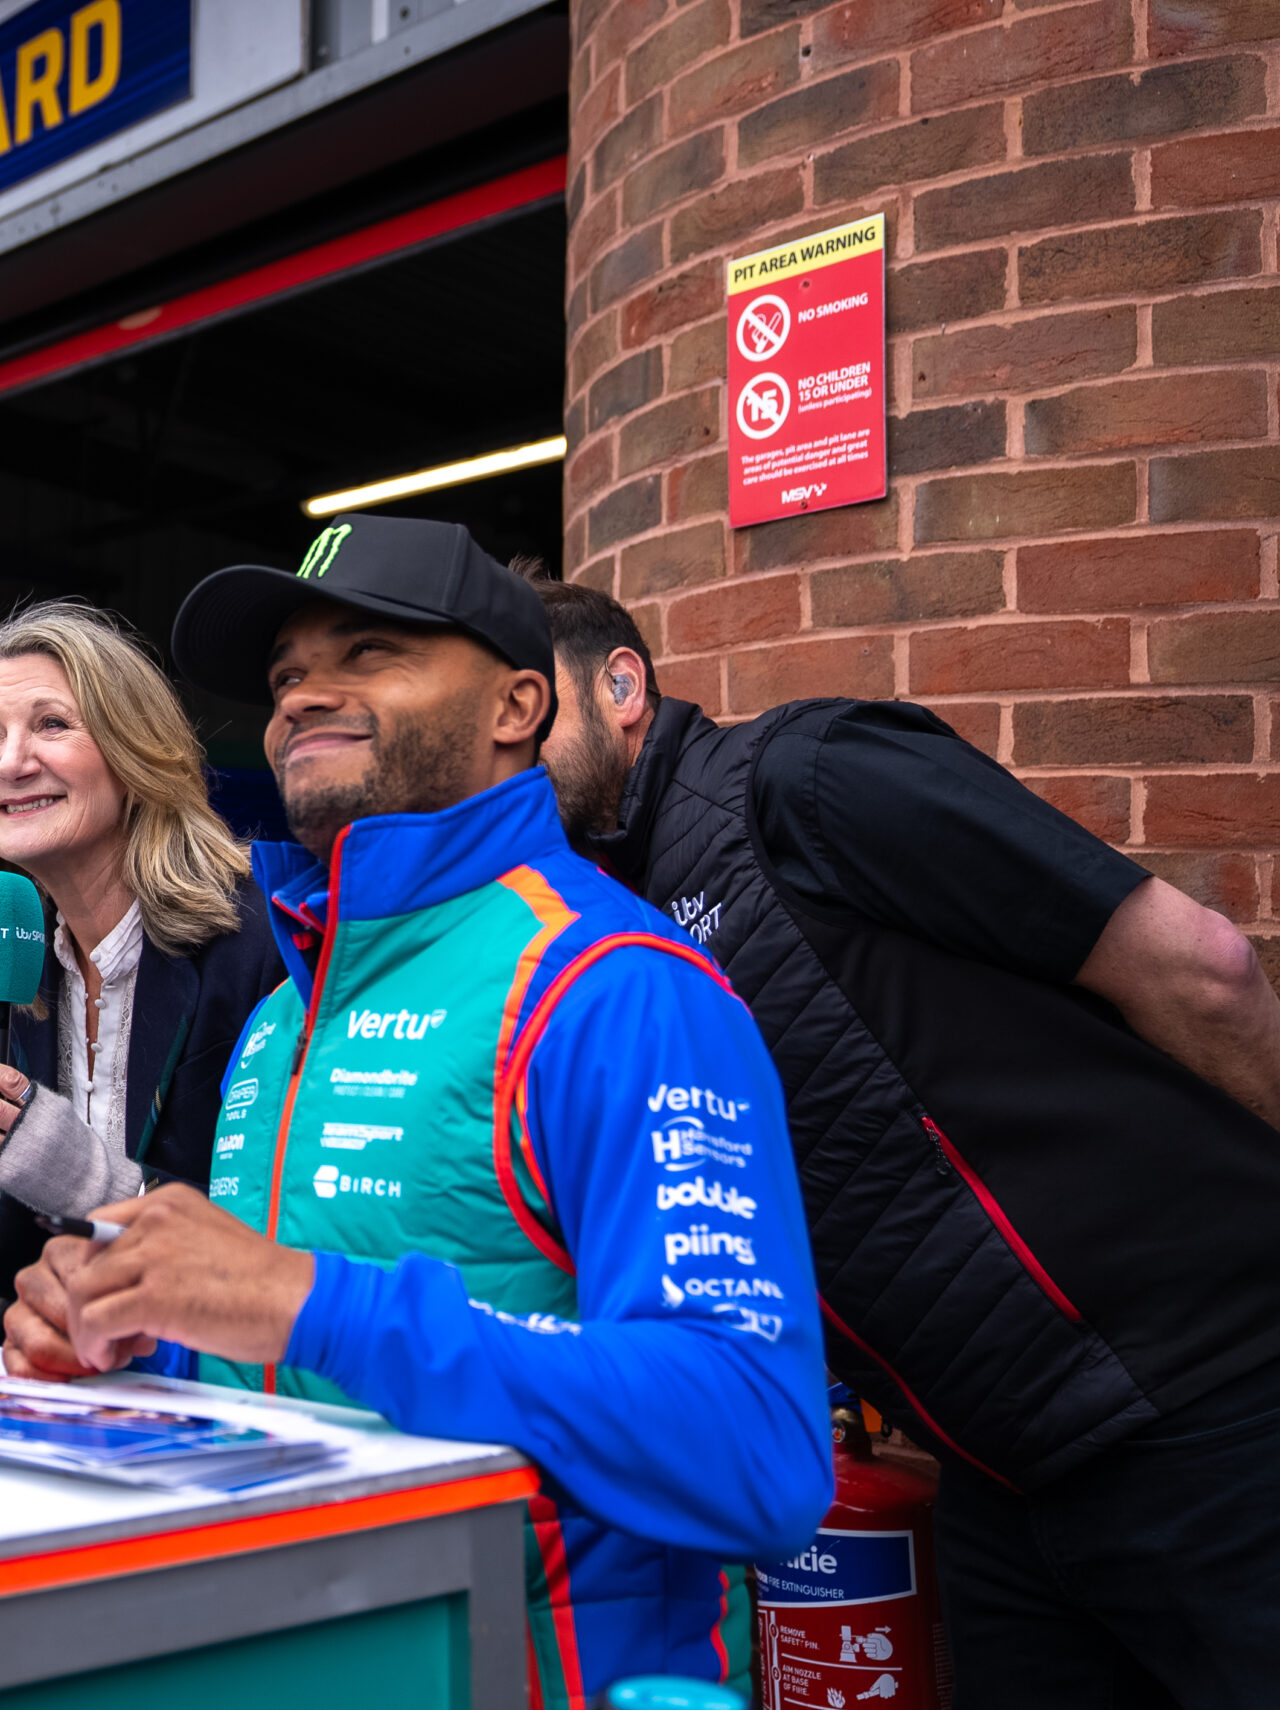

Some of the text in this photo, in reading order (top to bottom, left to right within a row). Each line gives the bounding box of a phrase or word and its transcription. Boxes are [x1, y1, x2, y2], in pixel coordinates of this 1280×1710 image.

[734, 226, 876, 283] PIT AREA WARNING
[798, 292, 869, 323] NO SMOKING
[798, 362, 871, 391] NO CHILDREN
[799, 375, 869, 402] 15 OR UNDER
[741, 455, 755, 464] The
[785, 445, 796, 455] pit
[796, 442, 813, 452] area
[813, 437, 827, 448] and
[828, 435, 839, 446] pit
[840, 431, 856, 440] lane
[857, 429, 870, 437] are
[743, 440, 868, 475] areas of potential danger and great
[743, 476, 758, 485] care
[759, 470, 783, 482] should
[783, 467, 793, 476] be
[828, 457, 836, 466] at
[837, 455, 847, 464] all
[847, 451, 868, 461] times
[671, 891, 705, 926] itv
[690, 903, 722, 944] ORT
[347, 1009, 431, 1040] Vertu
[330, 1067, 418, 1086] Diamondbrite
[339, 1174, 401, 1198] BIRCH
[664, 1224, 756, 1265] piing
[781, 1580, 845, 1599] EXTINGUISHER
[780, 1625, 806, 1639] REMOVE
[782, 1664, 821, 1680] AIM NOZZLE
[783, 1682, 791, 1690] OF
[791, 1675, 809, 1687] BASE
